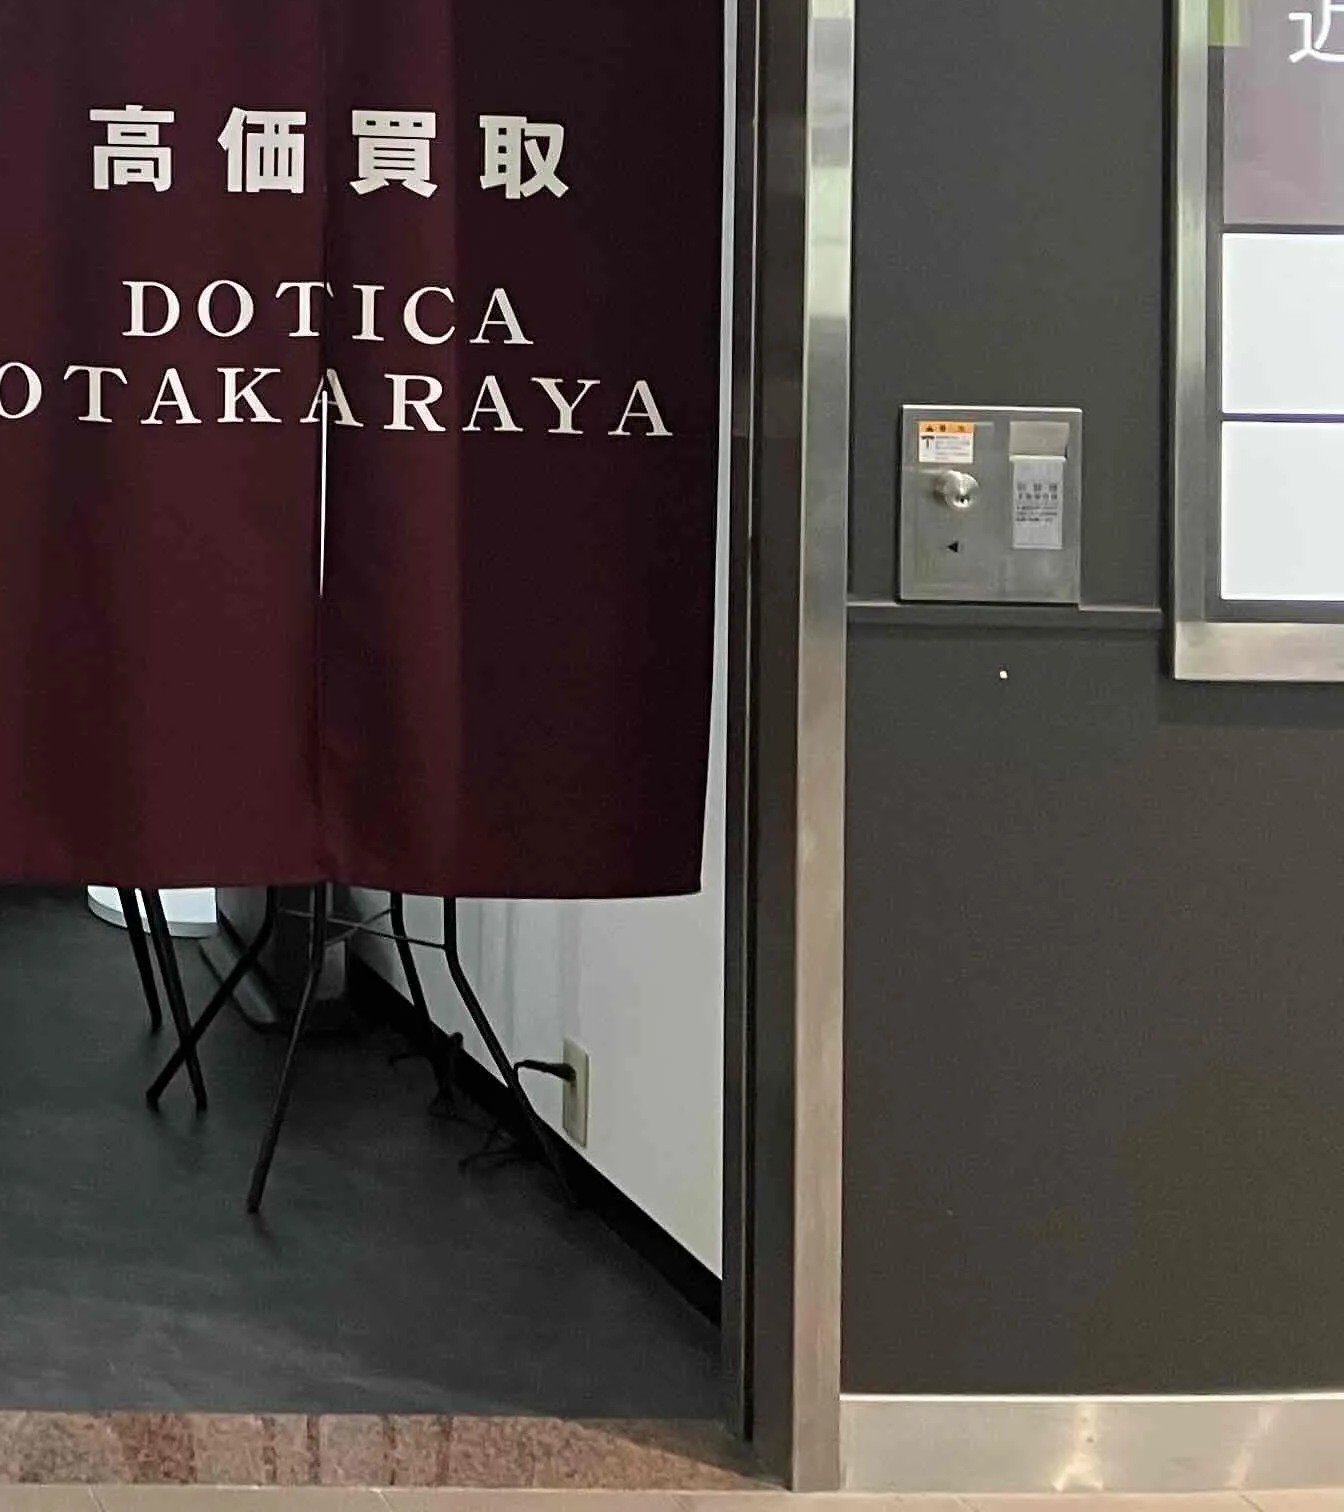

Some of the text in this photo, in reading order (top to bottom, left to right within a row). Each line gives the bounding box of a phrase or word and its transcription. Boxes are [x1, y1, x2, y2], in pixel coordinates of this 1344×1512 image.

[87, 103, 570, 200] 高価買取
[121, 278, 535, 345] DOTICA
